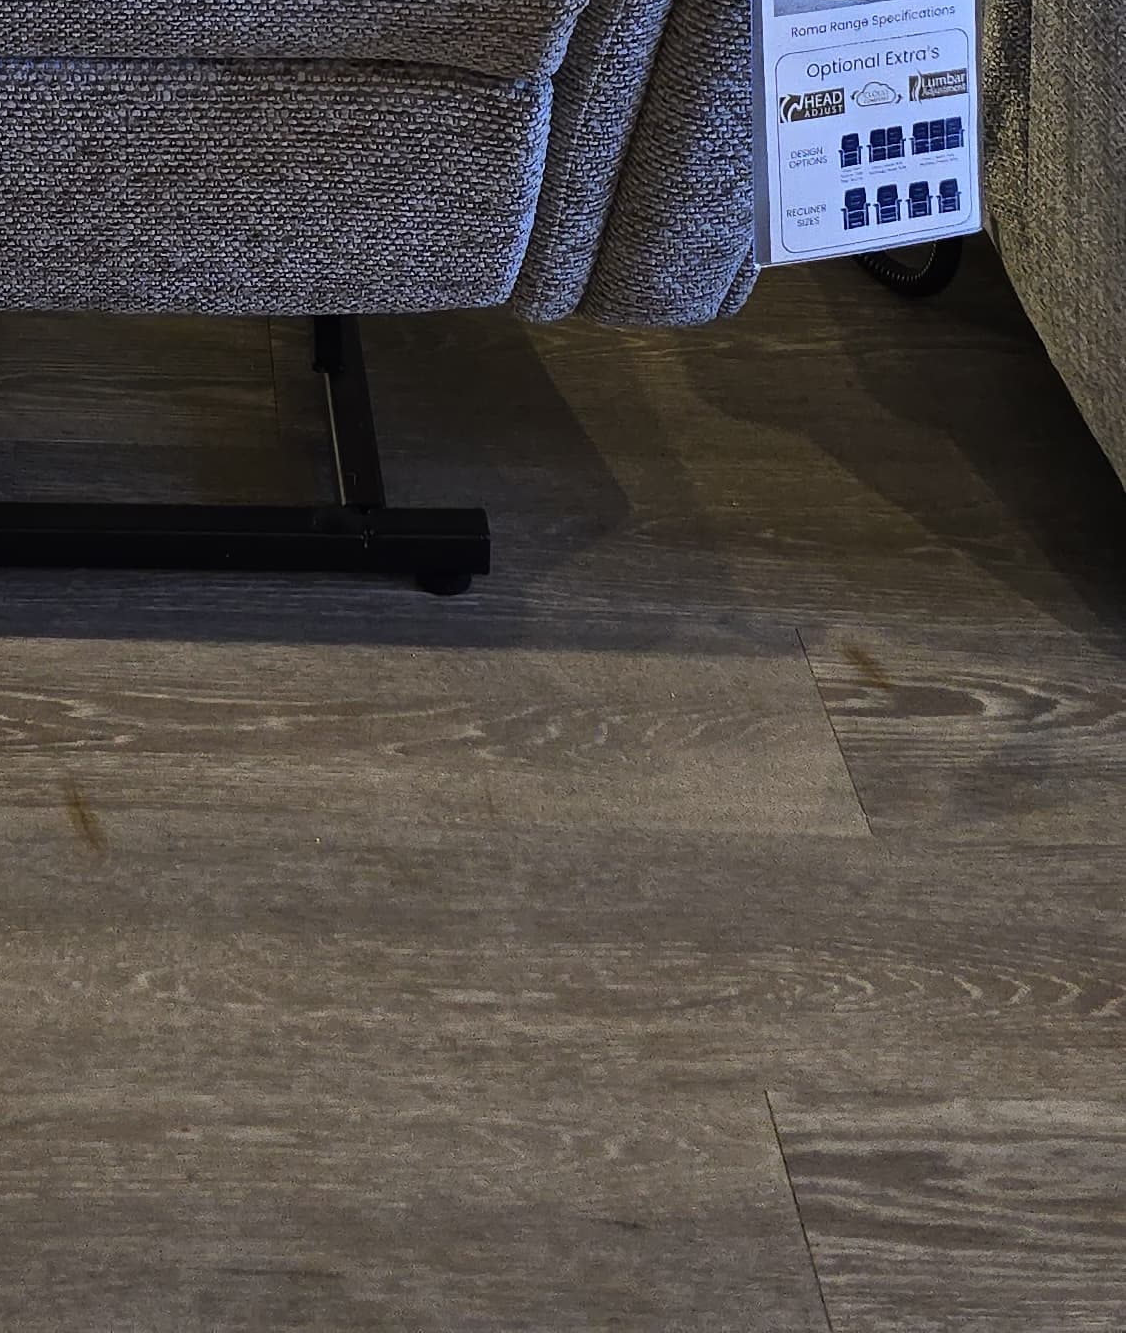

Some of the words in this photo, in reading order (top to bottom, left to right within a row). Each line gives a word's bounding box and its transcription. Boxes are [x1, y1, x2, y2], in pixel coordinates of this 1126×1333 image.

[791, 24, 827, 38] Roma
[830, 17, 869, 33] Range
[872, 5, 956, 26] Specifications
[807, 52, 880, 80] Optional
[885, 45, 940, 66] Extra's
[921, 72, 966, 88] Lumbar
[804, 91, 843, 108] HEAD
[804, 105, 843, 118] ADJUST
[790, 146, 823, 159] DESIGN
[789, 156, 828, 170] OPTIONS
[786, 203, 827, 218] RECLINER
[796, 216, 820, 227] SIZES
